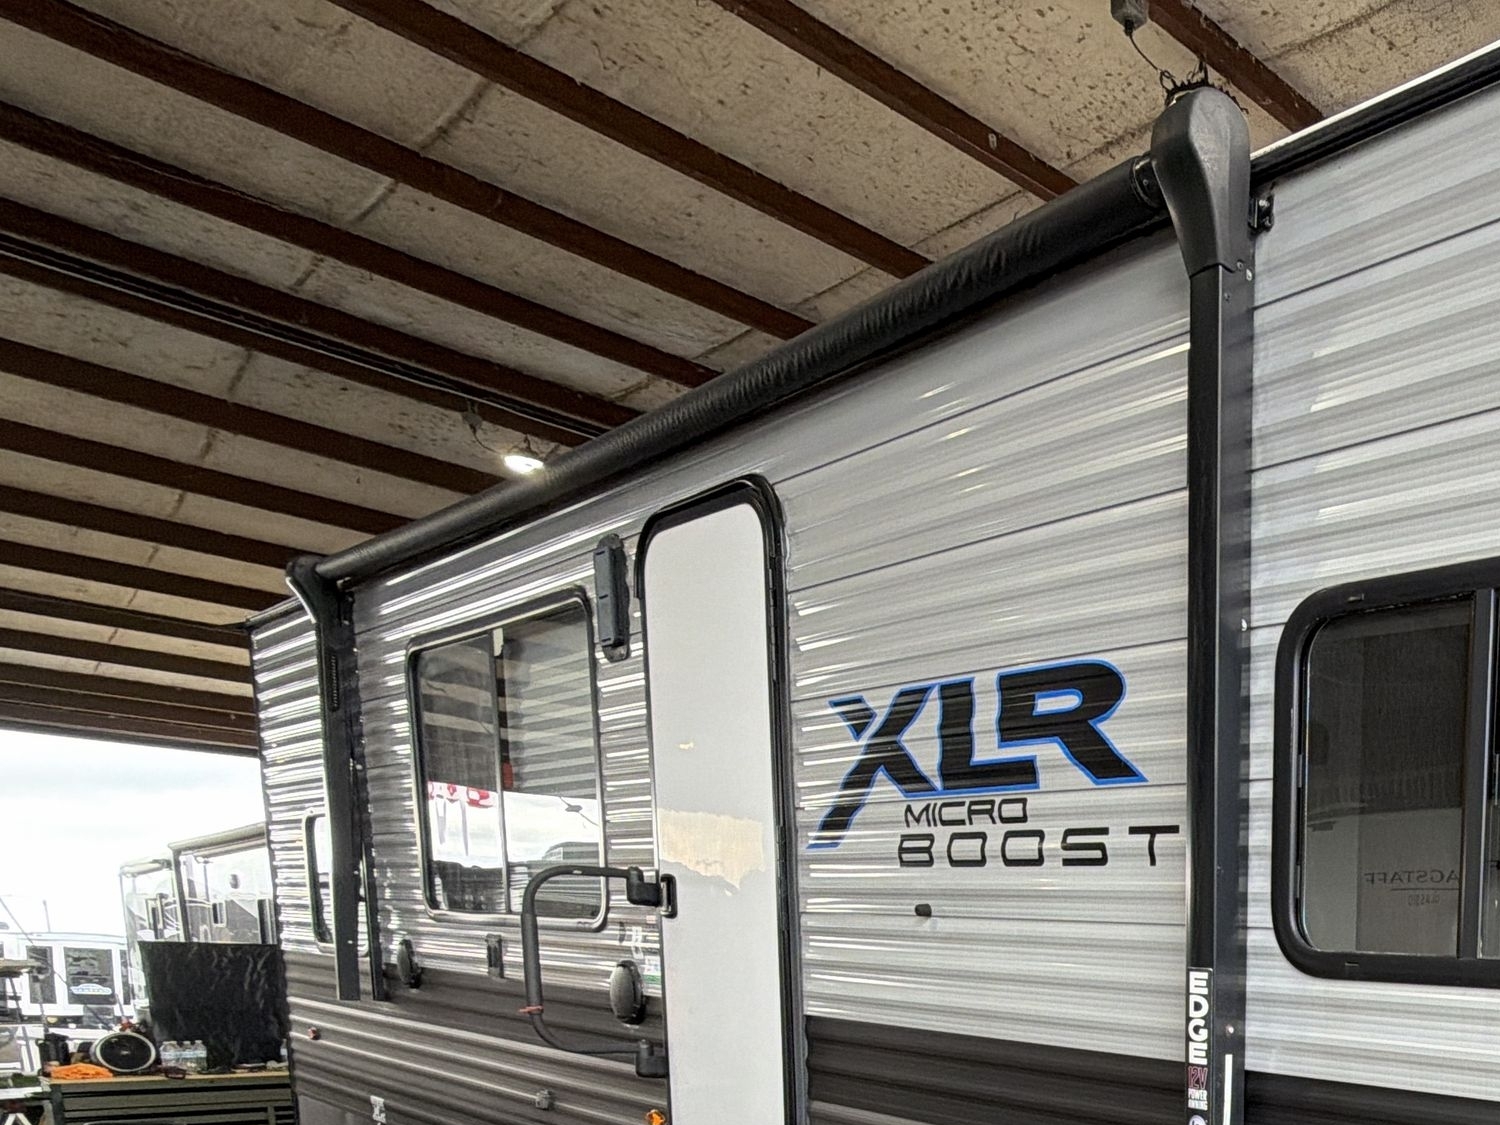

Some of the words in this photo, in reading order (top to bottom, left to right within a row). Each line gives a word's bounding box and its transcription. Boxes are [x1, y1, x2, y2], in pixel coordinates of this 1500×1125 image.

[806, 658, 1148, 850] XLR
[904, 797, 1028, 828] MICRO
[899, 824, 1180, 867] BOOST
[1188, 971, 1209, 1065] EDGE
[1188, 1066, 1208, 1089] 12V
